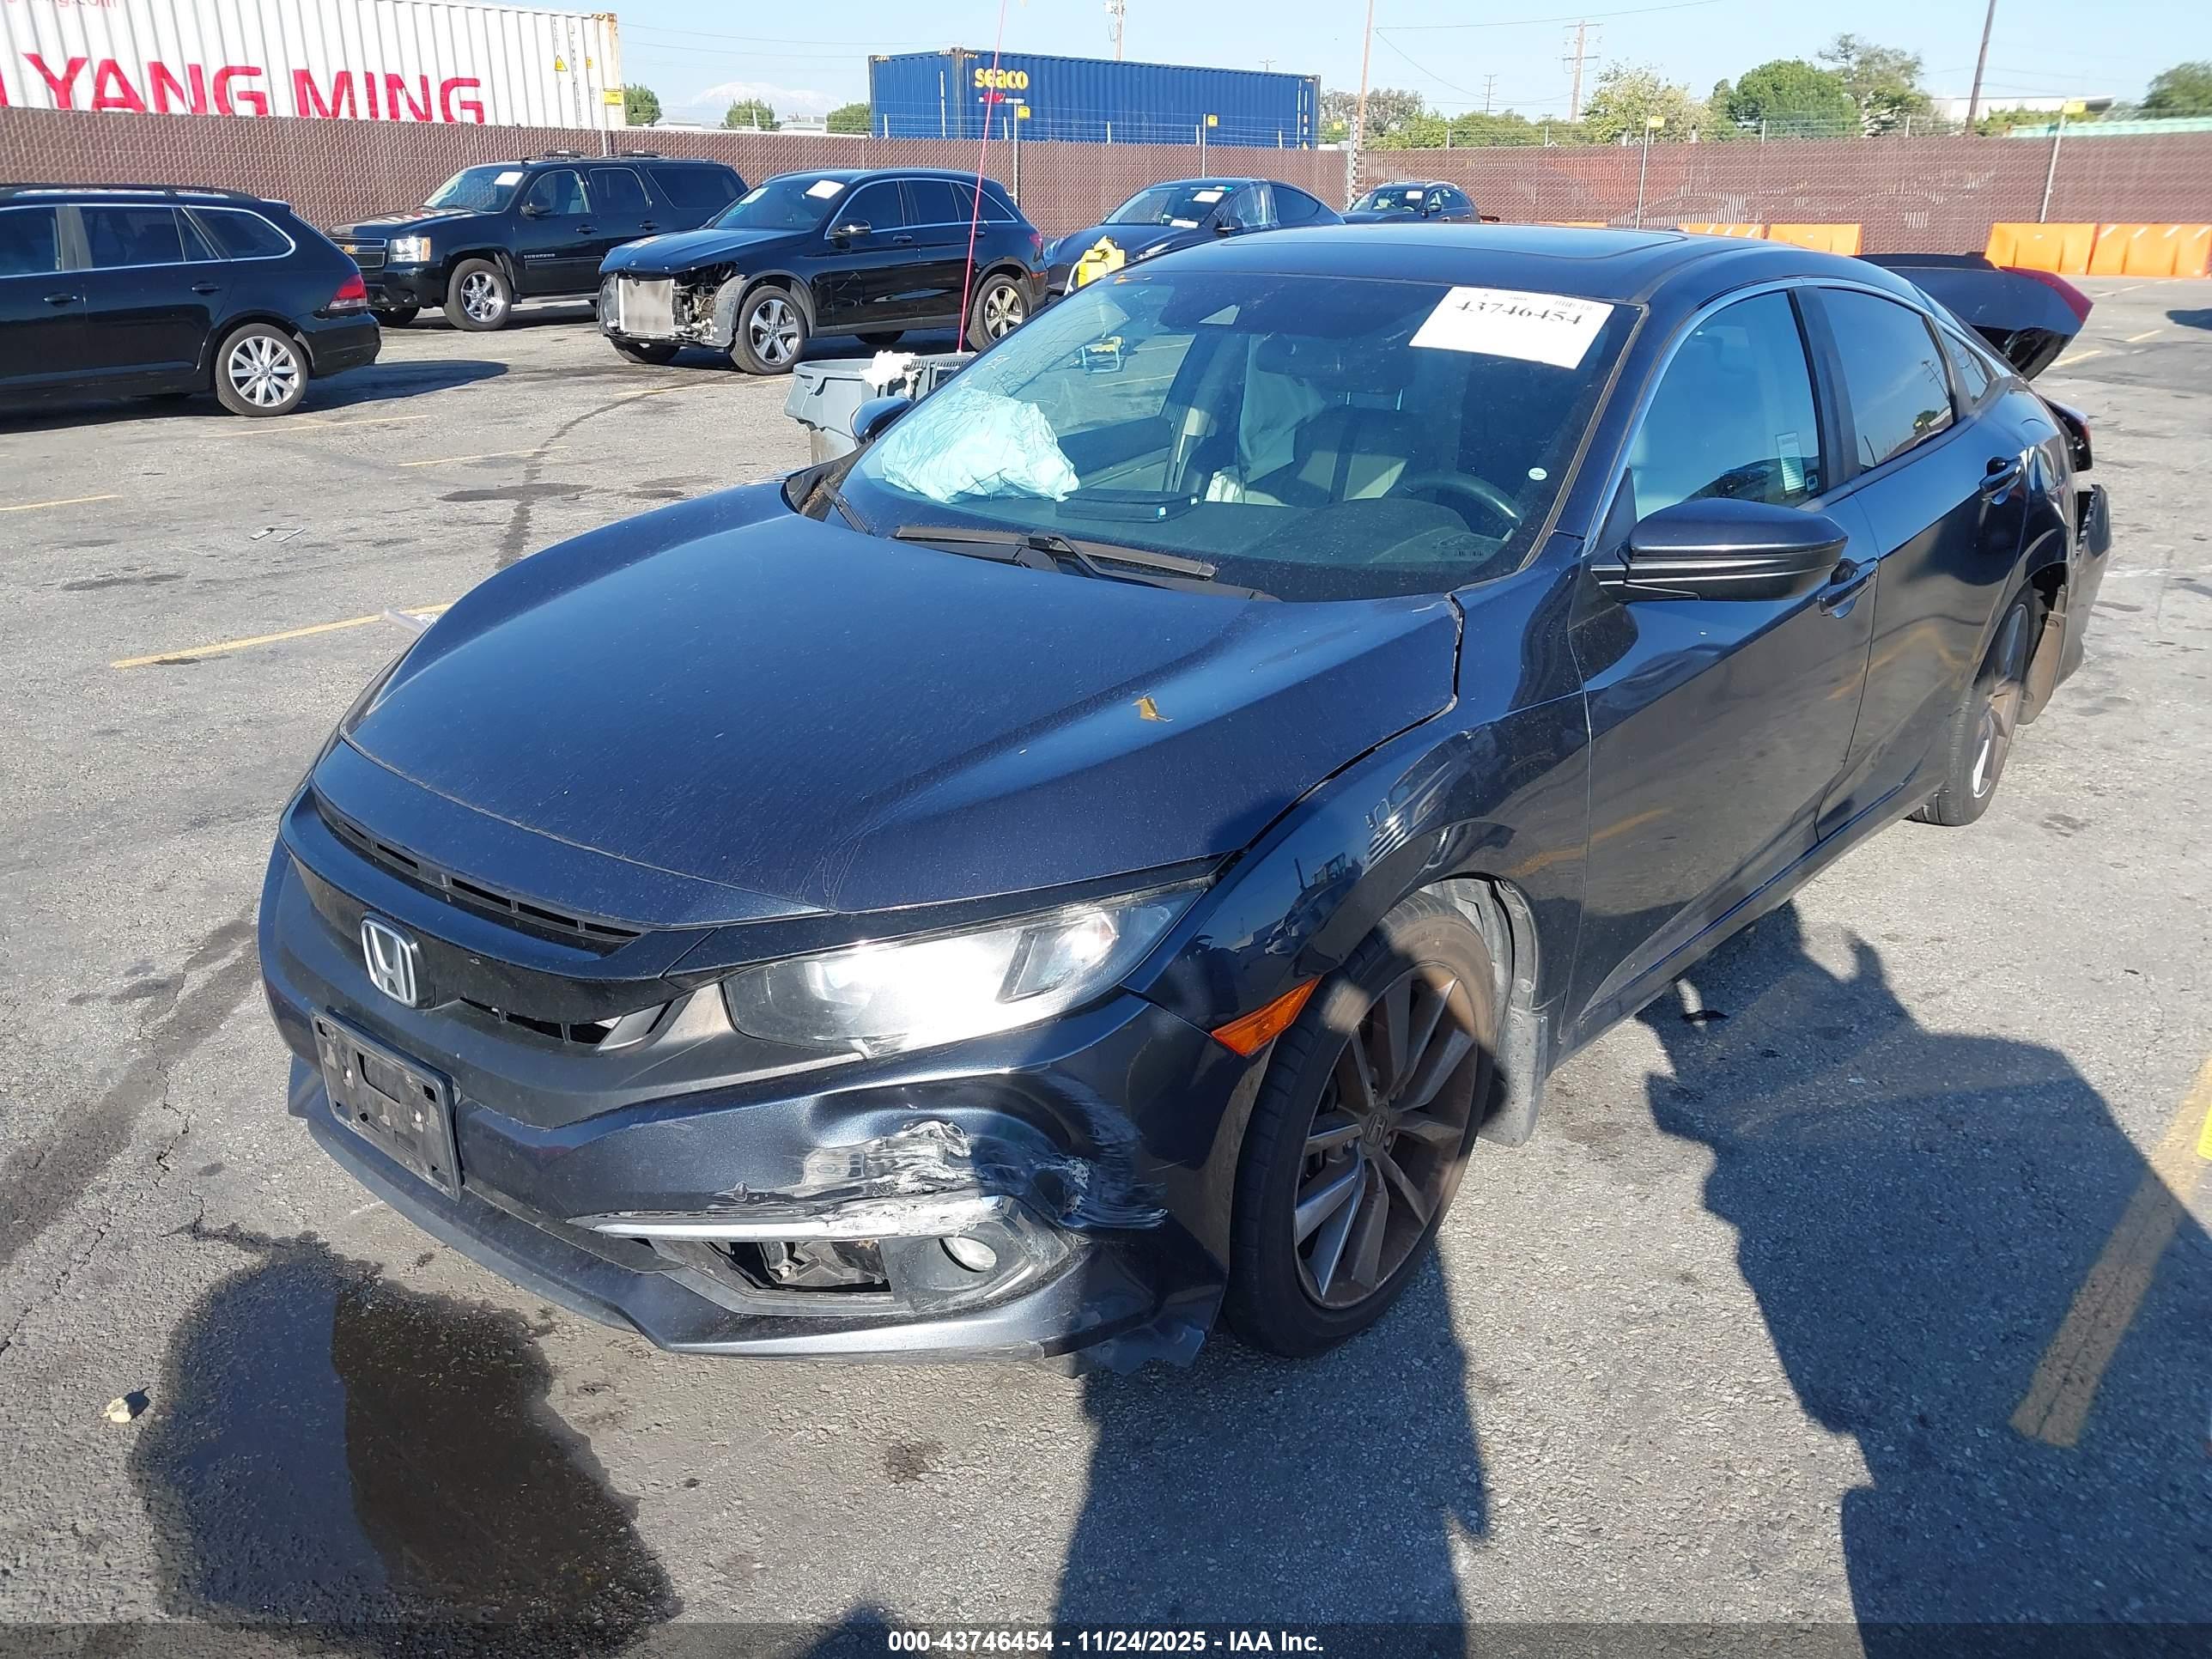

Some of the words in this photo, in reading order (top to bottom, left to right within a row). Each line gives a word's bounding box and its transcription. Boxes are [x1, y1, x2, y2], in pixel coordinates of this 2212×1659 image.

[22, 53, 269, 117] YANG
[293, 69, 485, 125] MING
[975, 68, 1029, 89] seaco
[1456, 300, 1583, 325] 43746454
